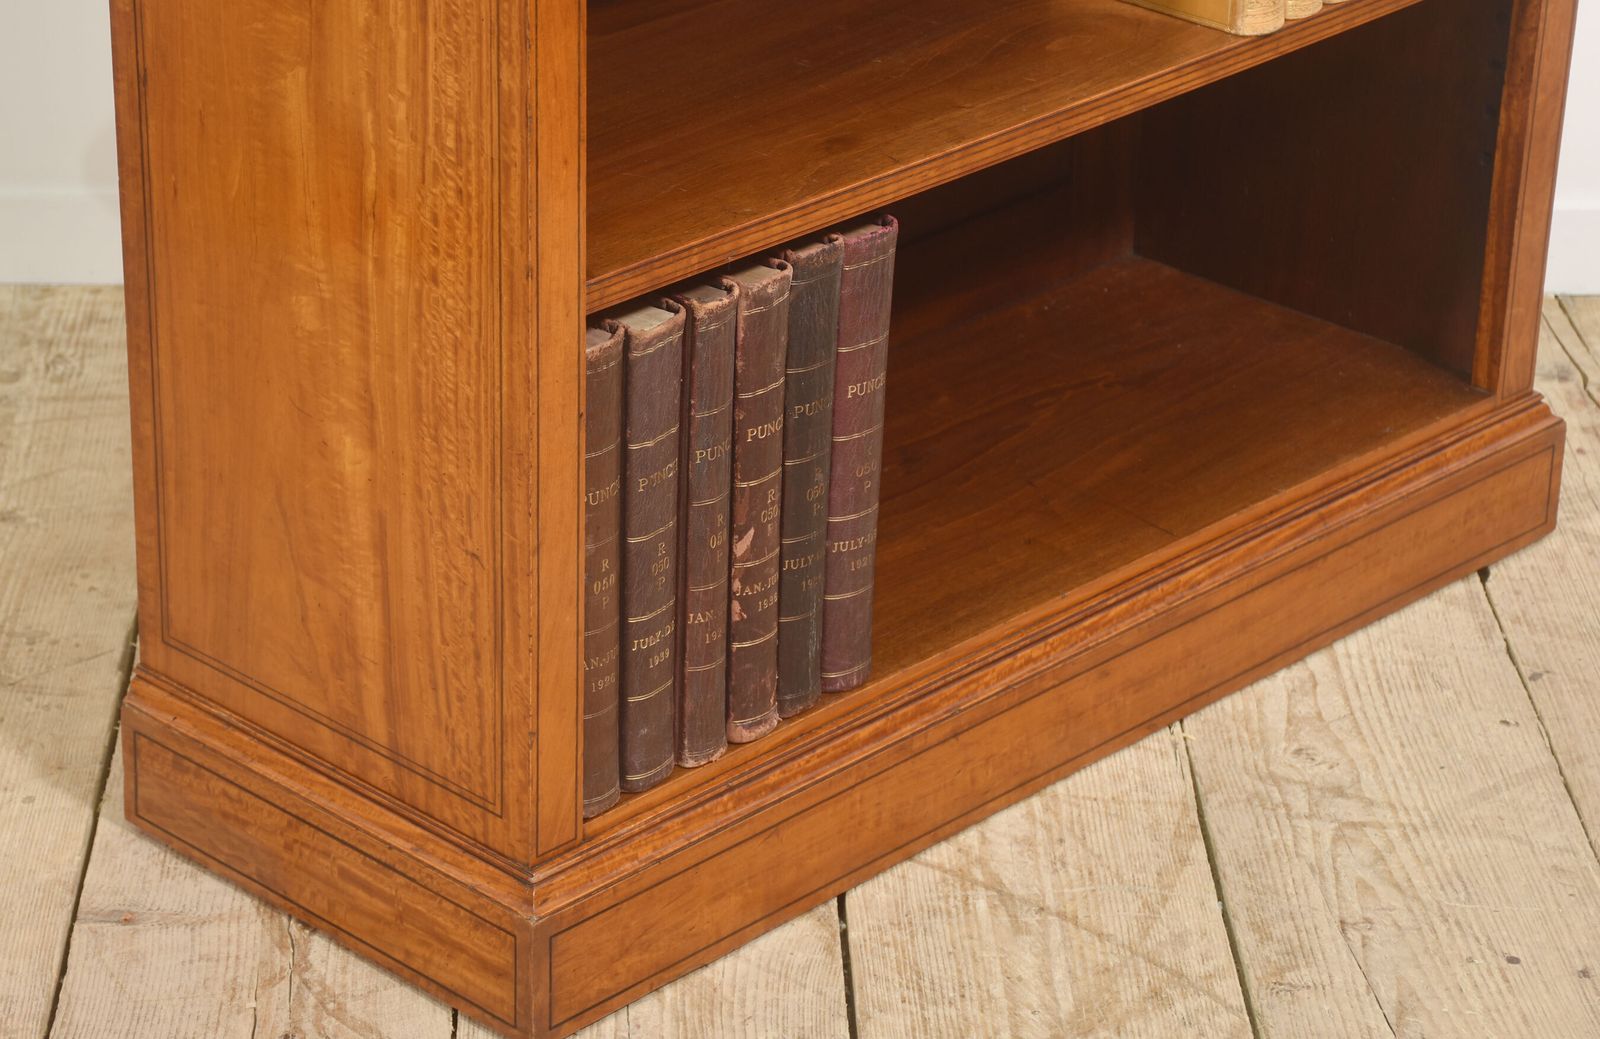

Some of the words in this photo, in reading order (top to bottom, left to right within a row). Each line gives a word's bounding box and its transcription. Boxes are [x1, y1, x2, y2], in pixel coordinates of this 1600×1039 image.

[696, 439, 731, 465] PUNC
[855, 461, 877, 478] 050
[767, 488, 777, 502] R
[806, 483, 825, 502] 050
[863, 480, 872, 494] P
[717, 513, 724, 527] R
[760, 504, 780, 523] 050
[657, 542, 666, 556] R
[601, 558, 610, 572] R
[652, 557, 670, 576] 050
[593, 573, 615, 595] 050
[657, 576, 666, 592] P
[602, 596, 609, 610] P
